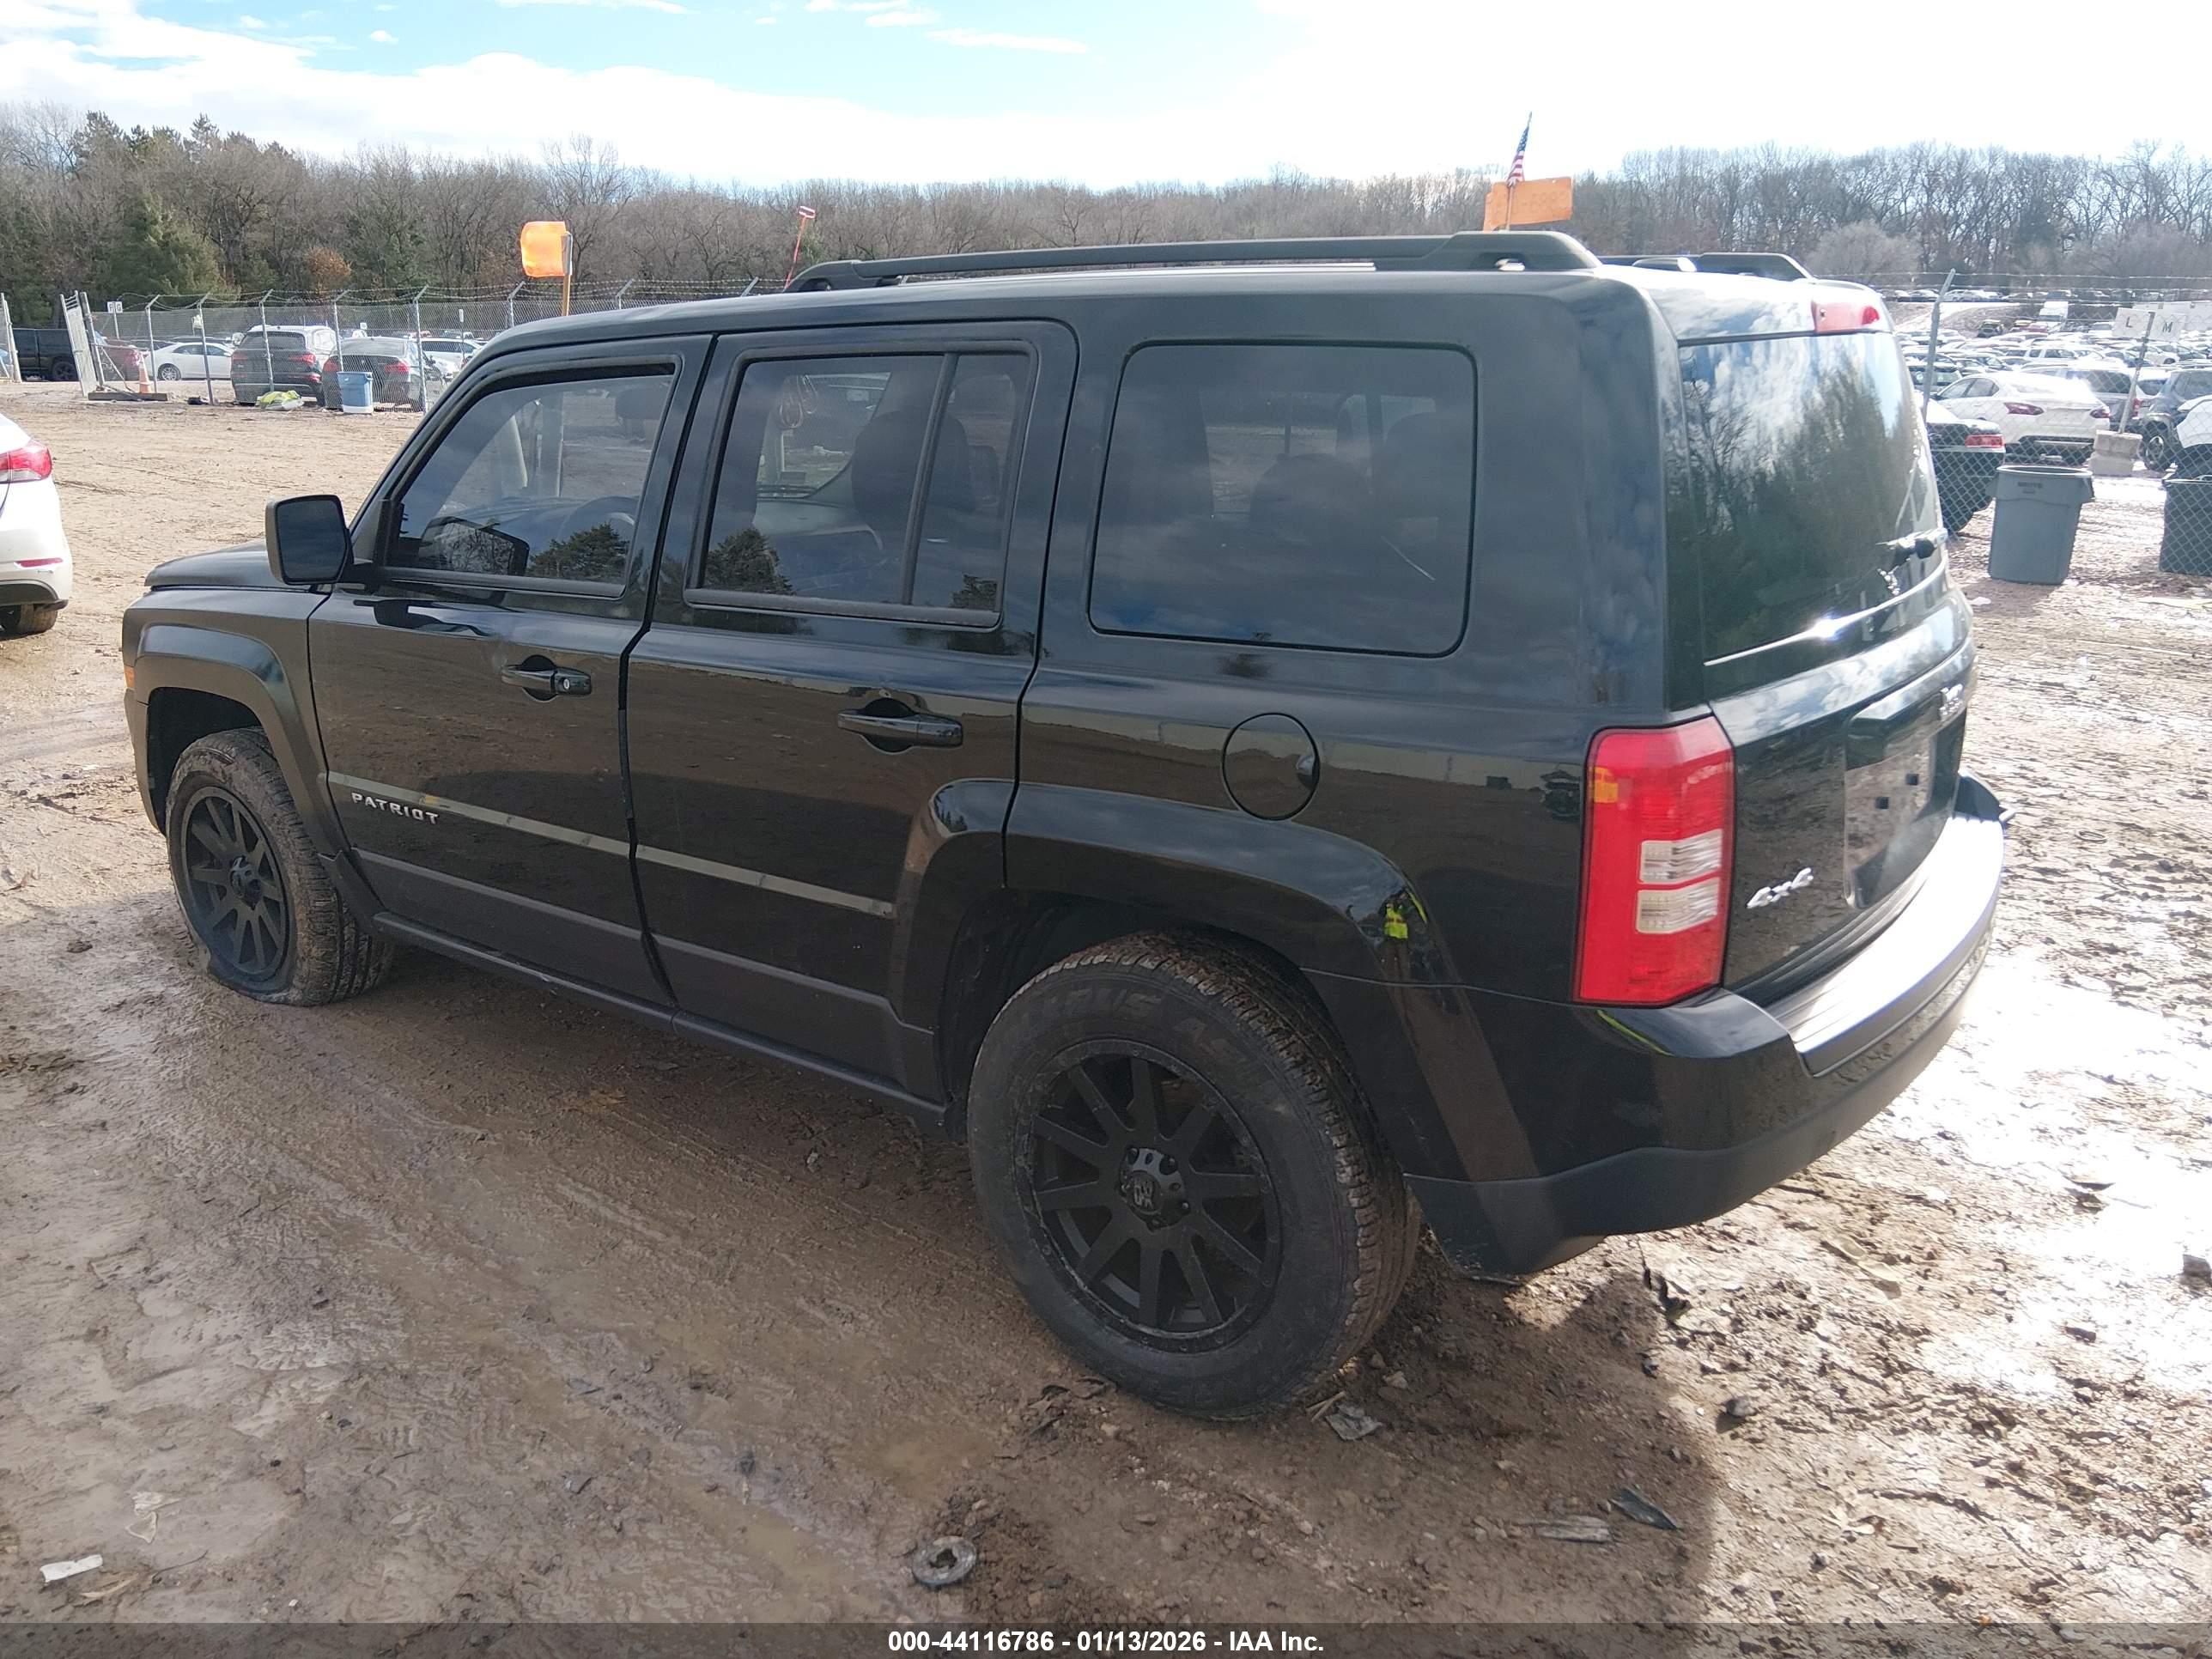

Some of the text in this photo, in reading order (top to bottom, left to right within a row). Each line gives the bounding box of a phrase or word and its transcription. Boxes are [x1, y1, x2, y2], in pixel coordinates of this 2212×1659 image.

[2125, 316, 2133, 328] L
[2162, 321, 2173, 333] M
[351, 792, 439, 824] PATRIOT
